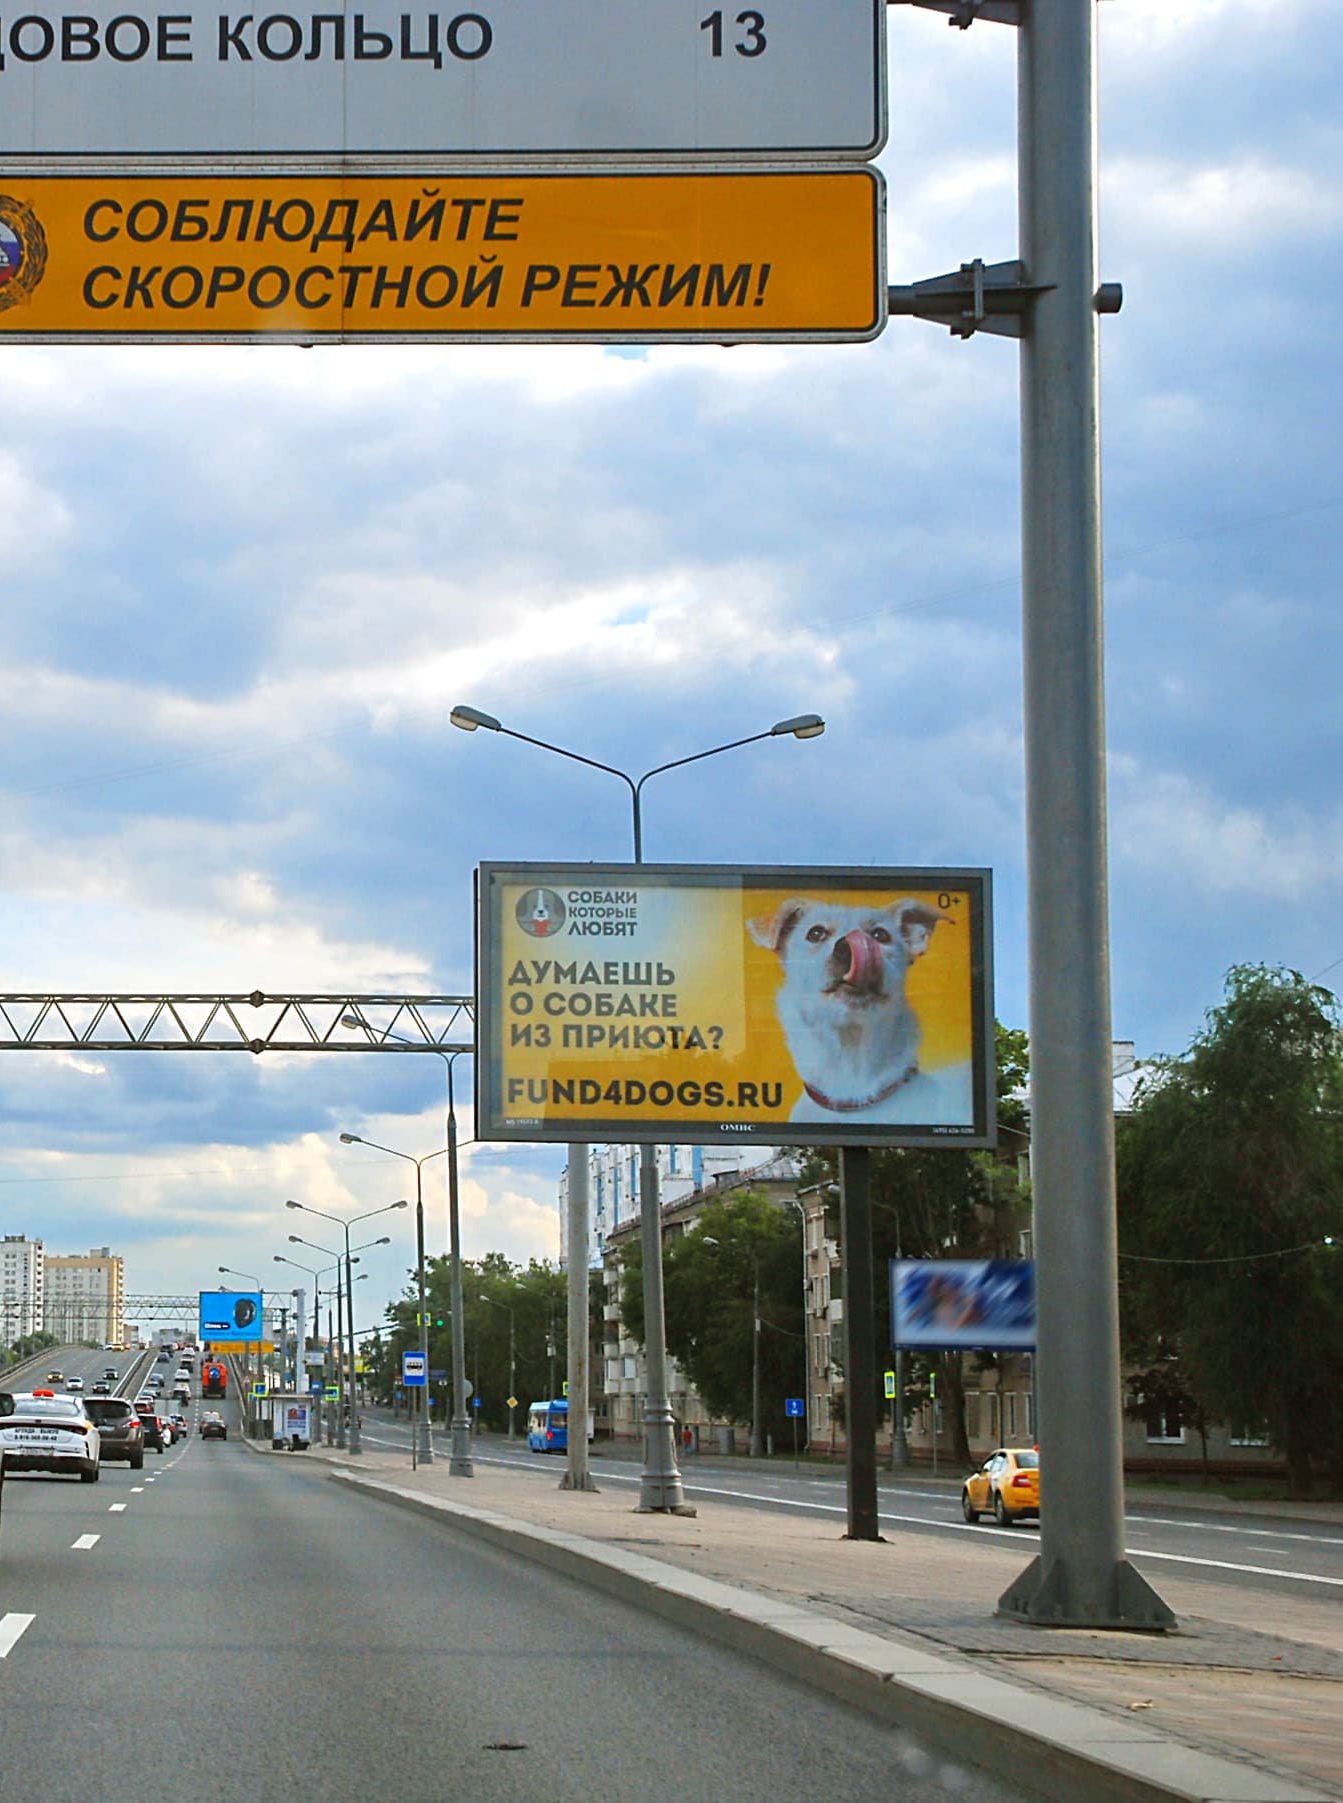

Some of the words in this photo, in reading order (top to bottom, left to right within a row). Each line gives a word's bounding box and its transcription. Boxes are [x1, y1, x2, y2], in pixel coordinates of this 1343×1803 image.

[218, 13, 494, 70] КОЛЬЦО
[699, 10, 768, 58] 13
[83, 187, 524, 253] СОБЛЮДАЙТЕ
[82, 253, 503, 310] СКОРОСТНОЙ
[521, 263, 772, 310] РЕЖИМ!
[567, 891, 638, 904] СОБАКИ
[568, 907, 637, 919] КОТОРЫЕ
[568, 921, 638, 936] ЛЮБЯТ
[508, 960, 675, 986] ДУМАЕШЬ
[509, 991, 534, 1016] О
[543, 992, 677, 1017] СОБАКЕ
[510, 1023, 551, 1047] ИЗ
[562, 1024, 724, 1050] ПРИЮТА?
[508, 1078, 783, 1108] FUND4DOGS.RU
